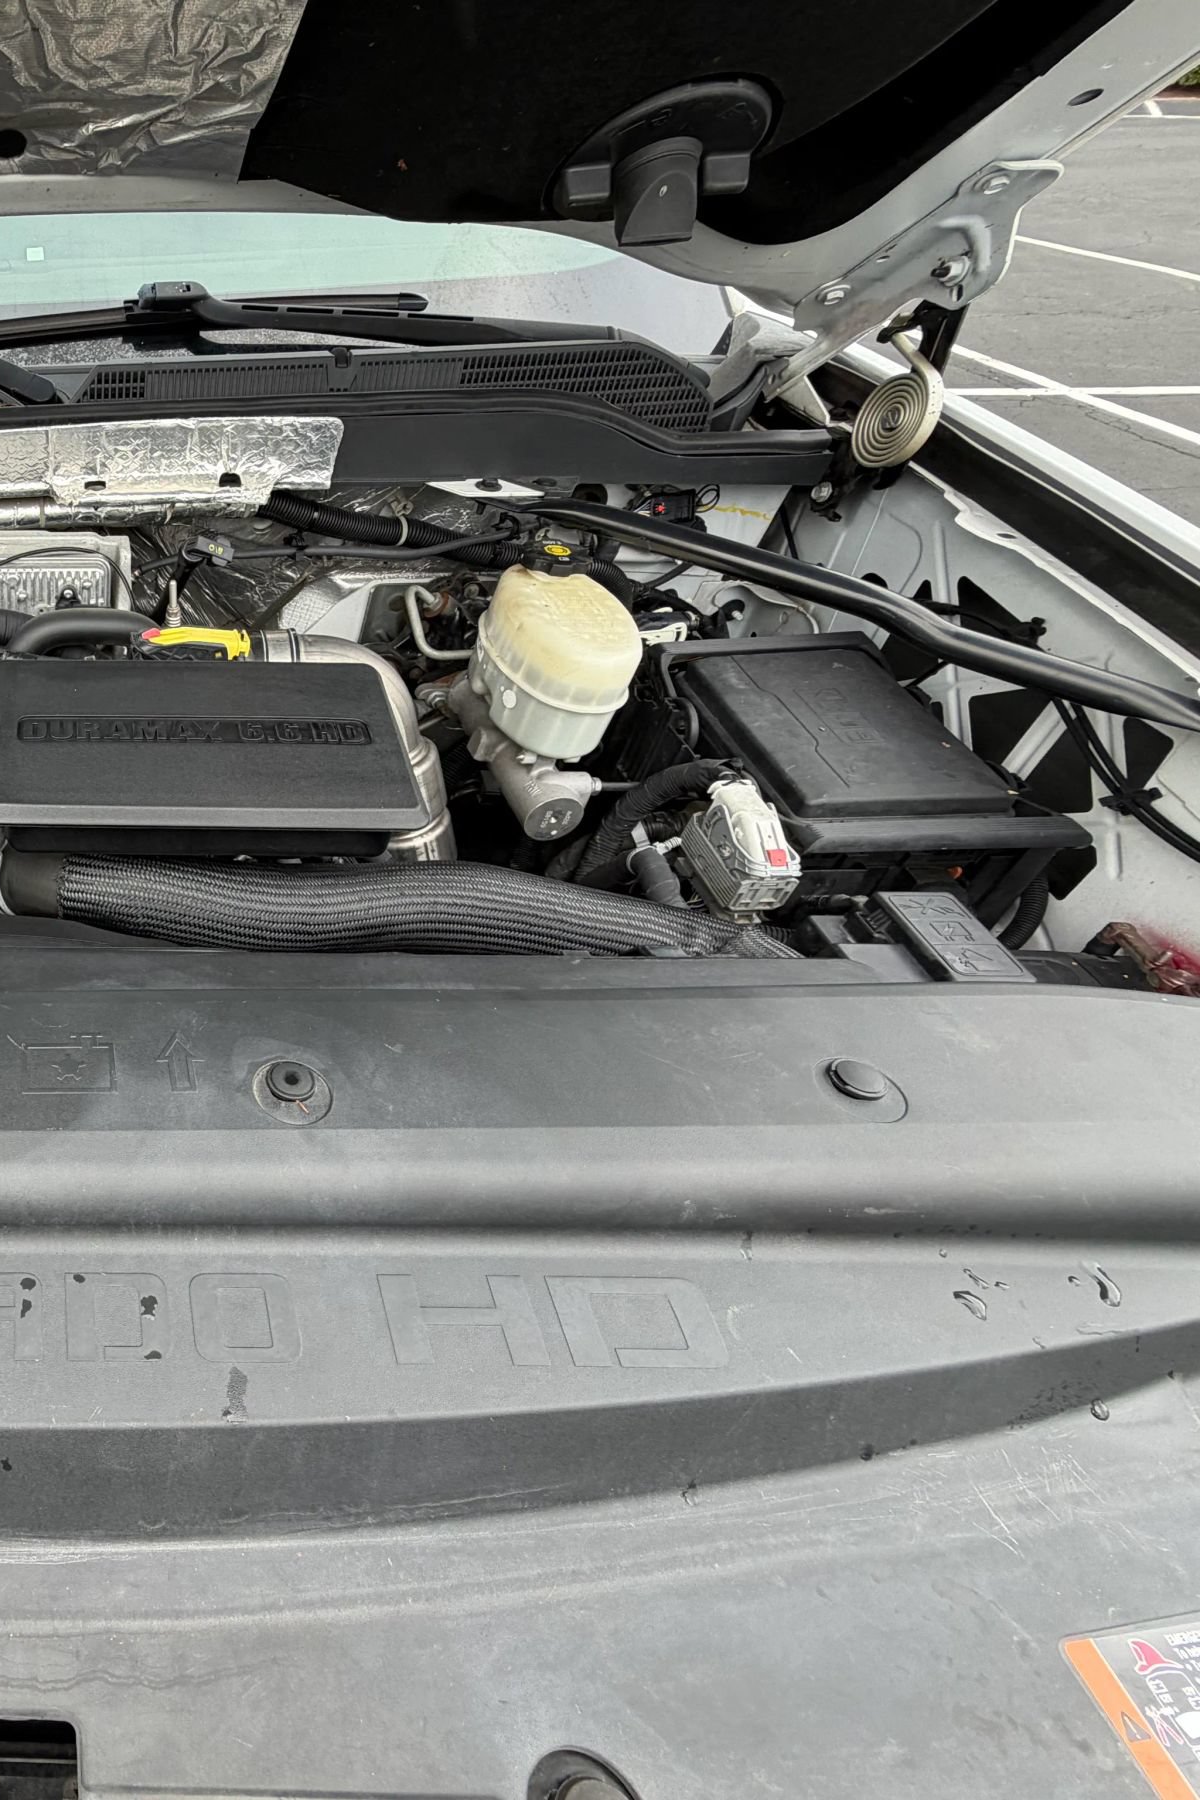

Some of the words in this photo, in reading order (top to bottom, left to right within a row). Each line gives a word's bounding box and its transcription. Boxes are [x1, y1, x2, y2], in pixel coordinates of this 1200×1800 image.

[22, 719, 222, 743] DURAMAX
[235, 721, 300, 743] 6.6
[307, 722, 371, 744] HD
[376, 1273, 729, 1369] HD
